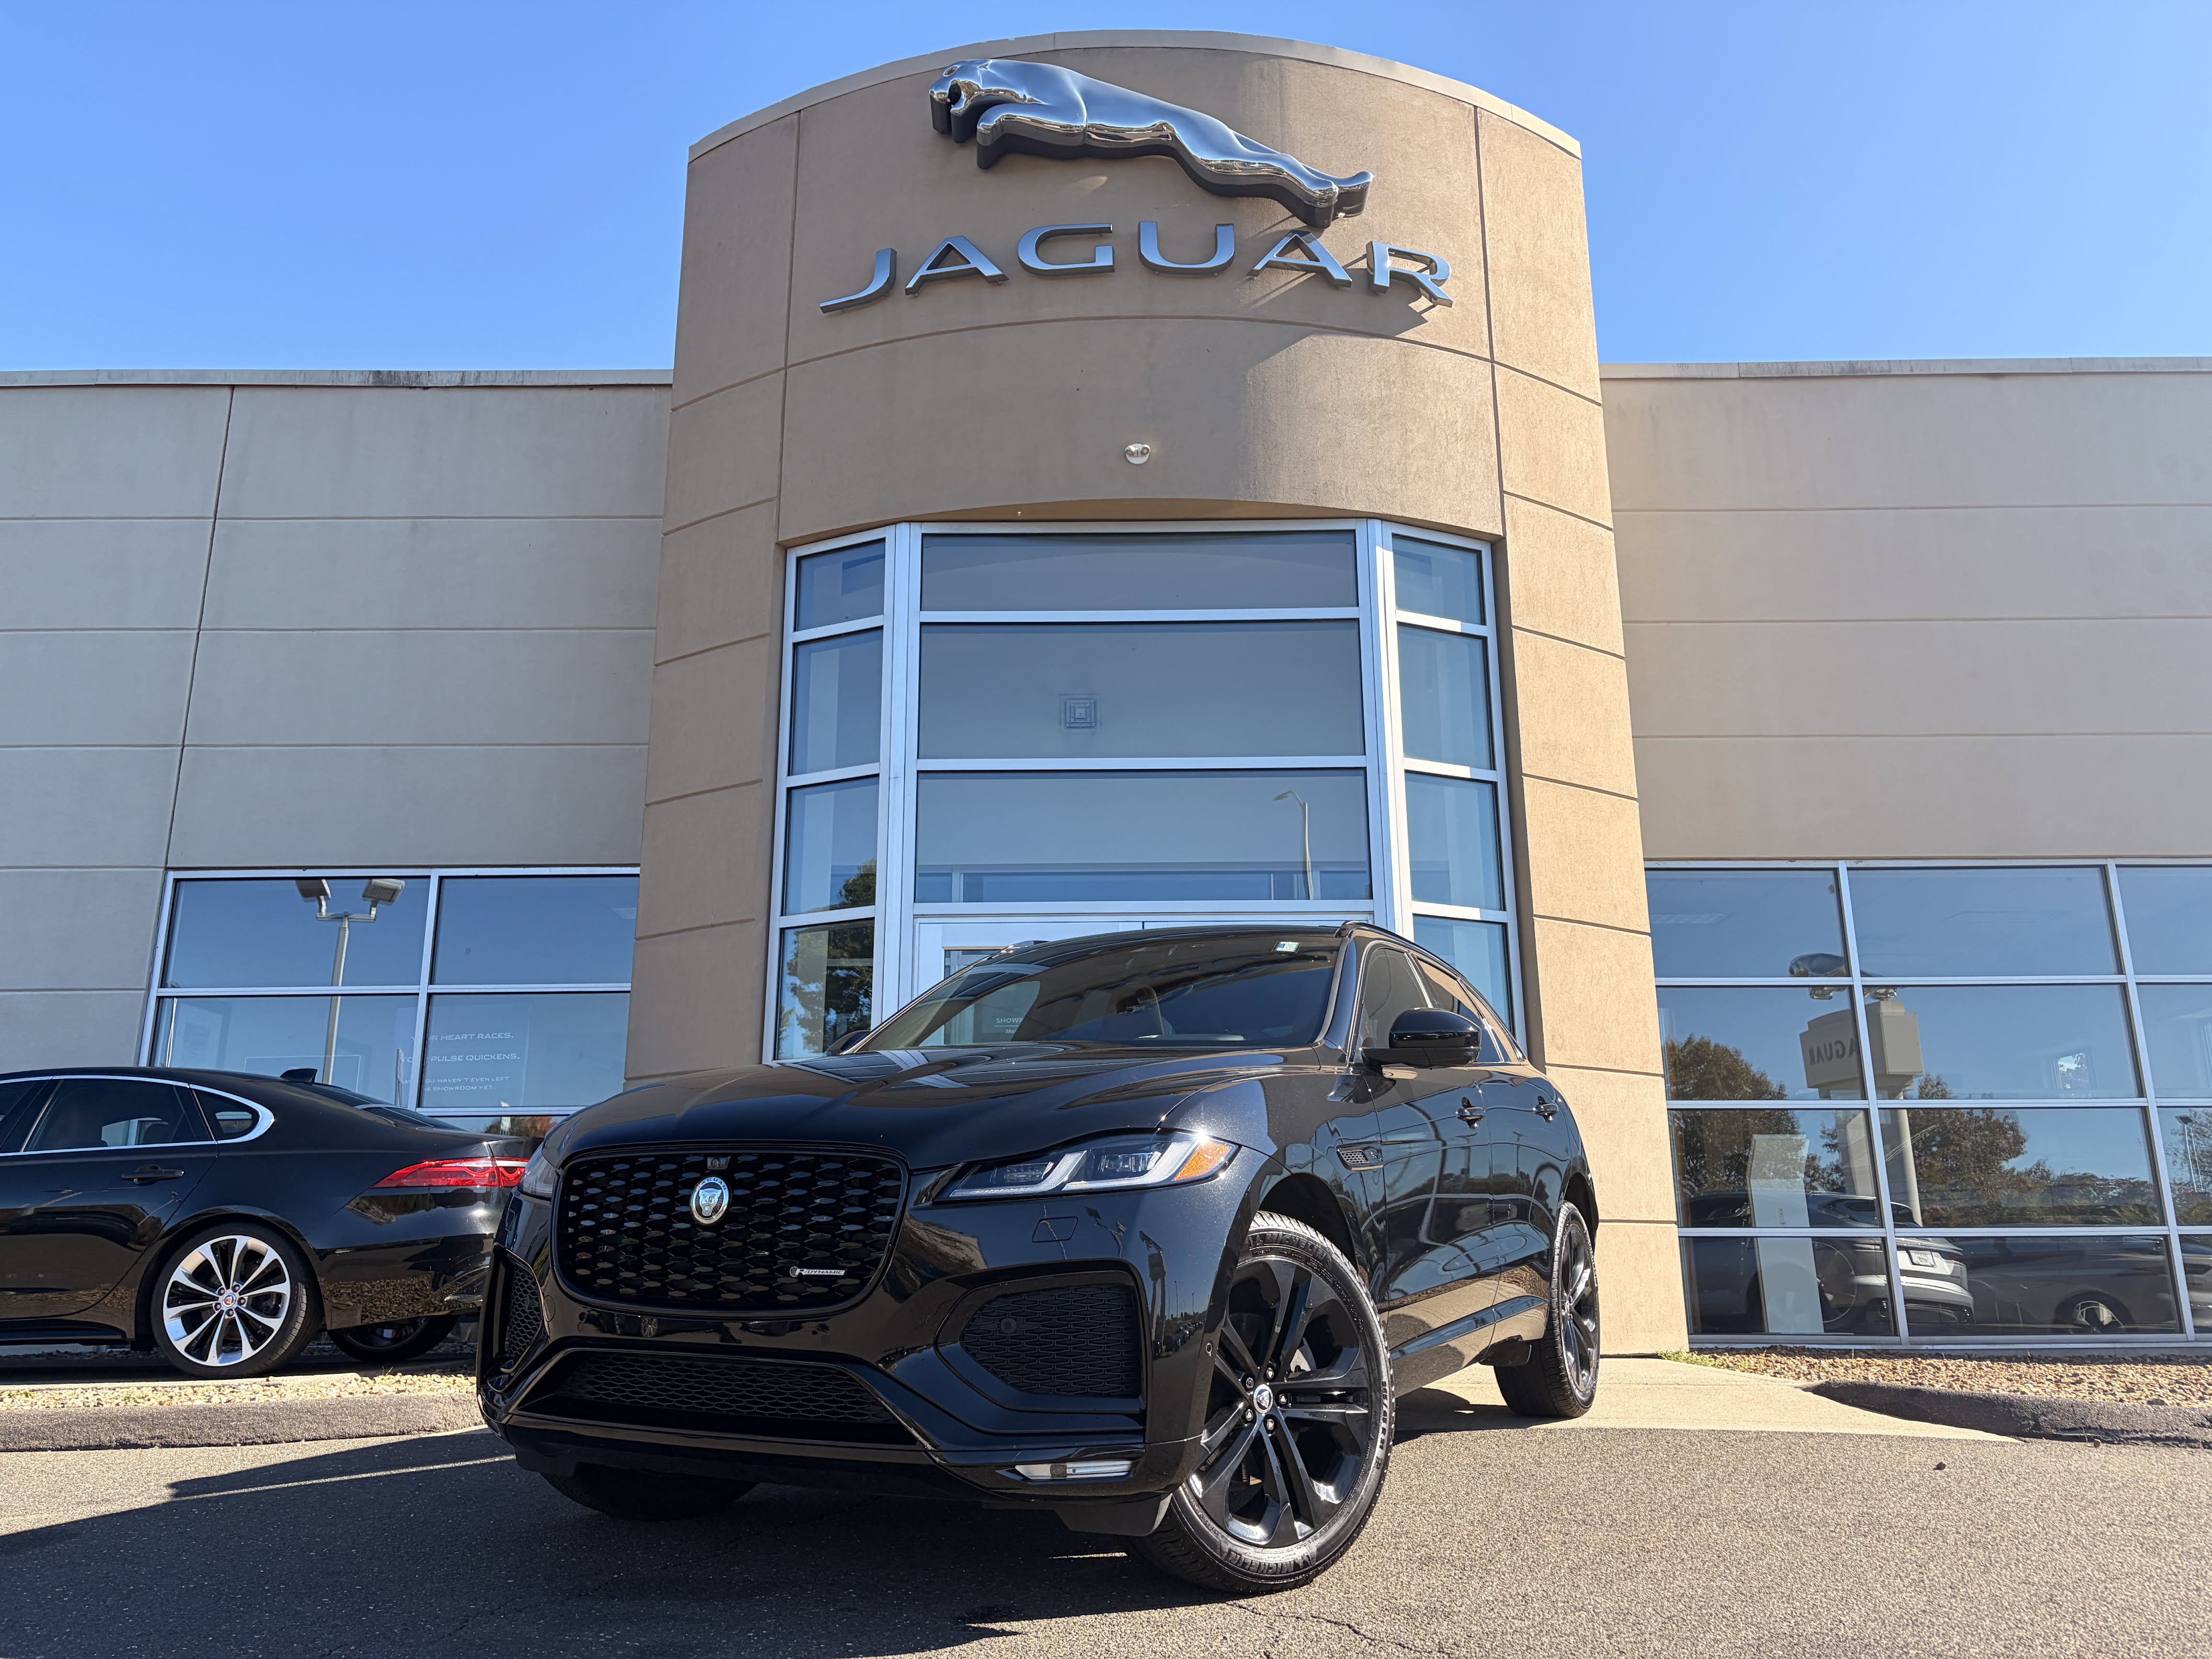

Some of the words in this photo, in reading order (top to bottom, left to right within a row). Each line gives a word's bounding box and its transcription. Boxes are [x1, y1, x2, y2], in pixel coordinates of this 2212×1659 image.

[820, 221, 1453, 314] JAGUAR
[466, 1053, 520, 1061] QUICKENS.
[698, 1177, 727, 1191] AGUAR
[1266, 1232, 1326, 1261] MICHELIN
[1228, 1551, 1294, 1575] MICHELIN
